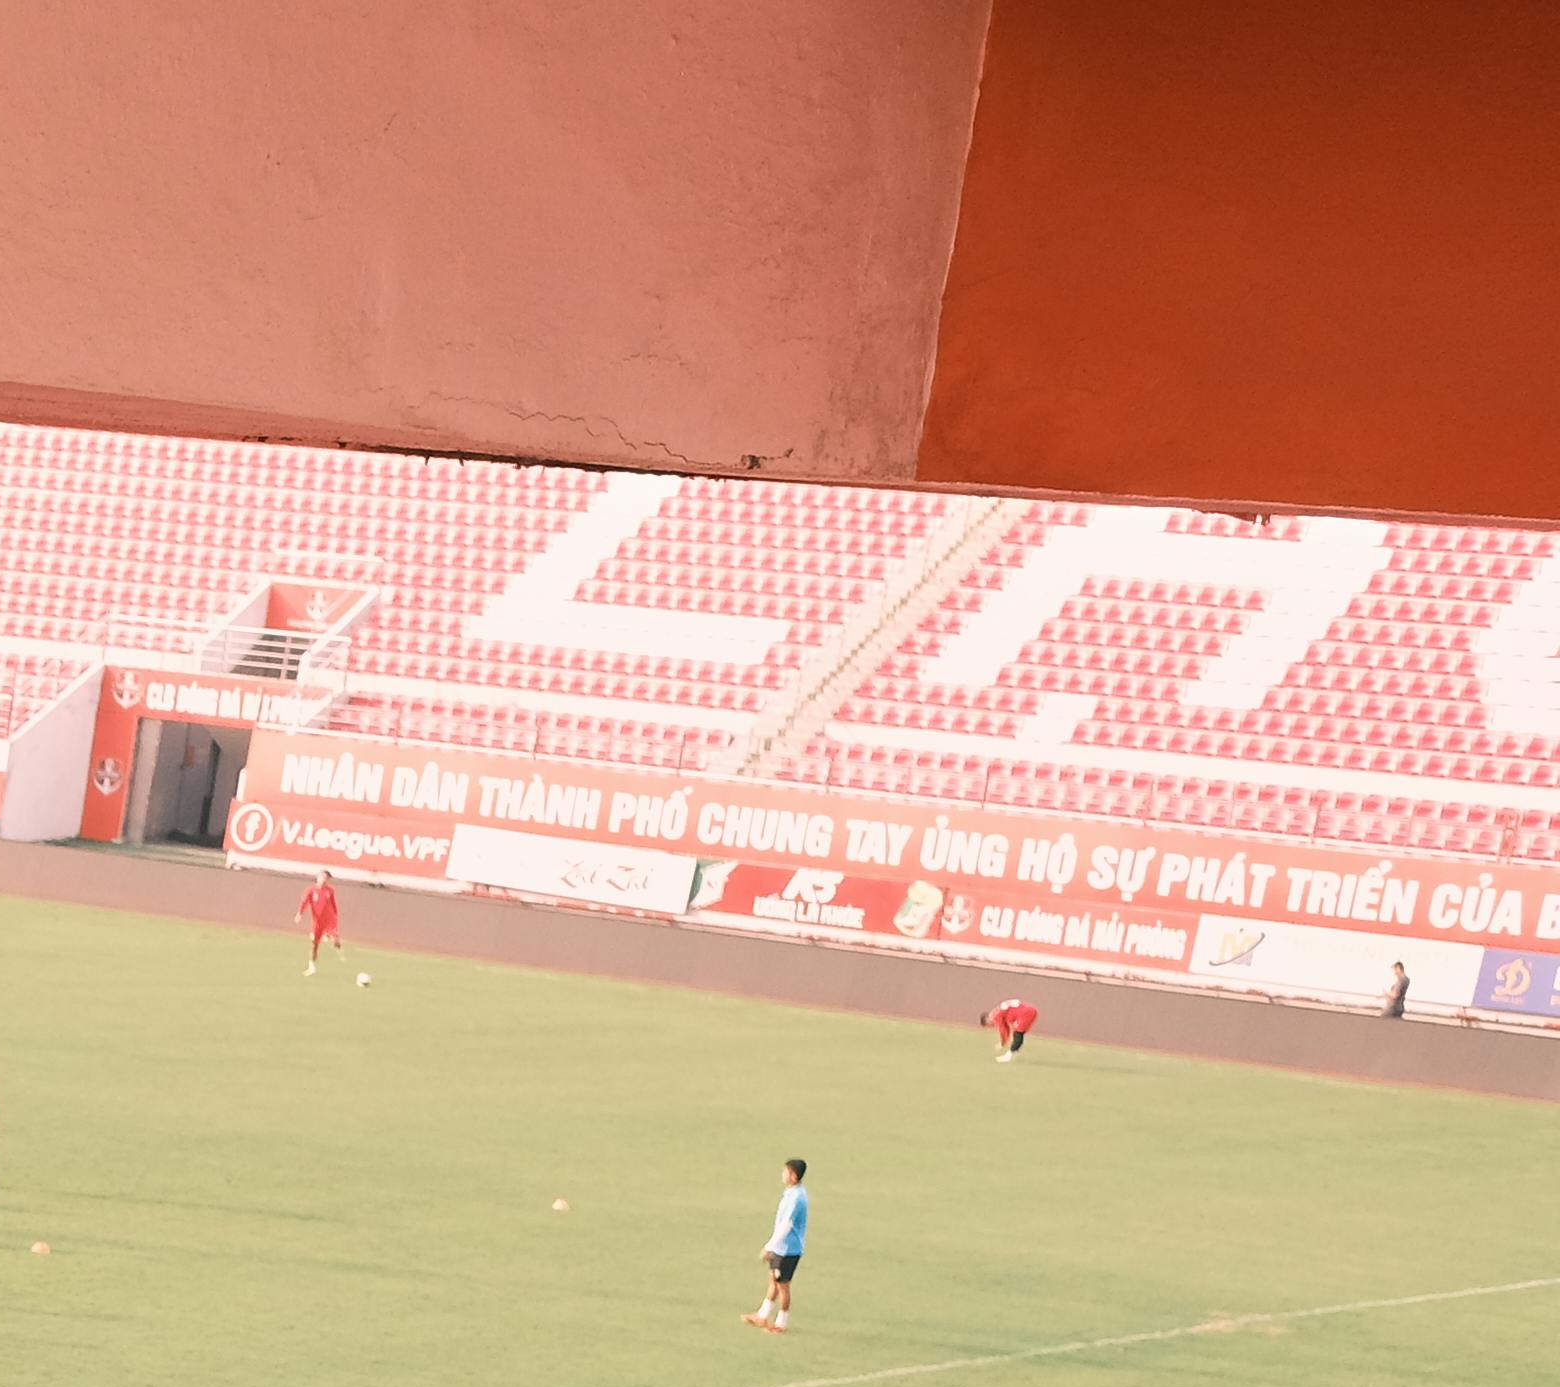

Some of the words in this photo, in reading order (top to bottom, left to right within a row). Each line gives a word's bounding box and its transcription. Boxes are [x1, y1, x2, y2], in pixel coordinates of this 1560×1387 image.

[146, 681, 175, 711] CLB
[279, 752, 384, 804] NHÂN
[389, 761, 470, 813] DÂN
[479, 773, 601, 833] THÀNH
[608, 785, 695, 840] PHỐ
[697, 802, 835, 858] CHUNG
[845, 818, 914, 867] TAY
[920, 814, 1010, 879] ỦNG
[1016, 832, 1080, 892] HỘ
[1087, 842, 1156, 903] SỰ
[1157, 852, 1277, 909] PHÁT
[1287, 859, 1421, 927] TRIỂN
[1427, 872, 1524, 936] CỦA
[282, 817, 450, 863] V.League.VPF
[979, 905, 1015, 939] CLB
